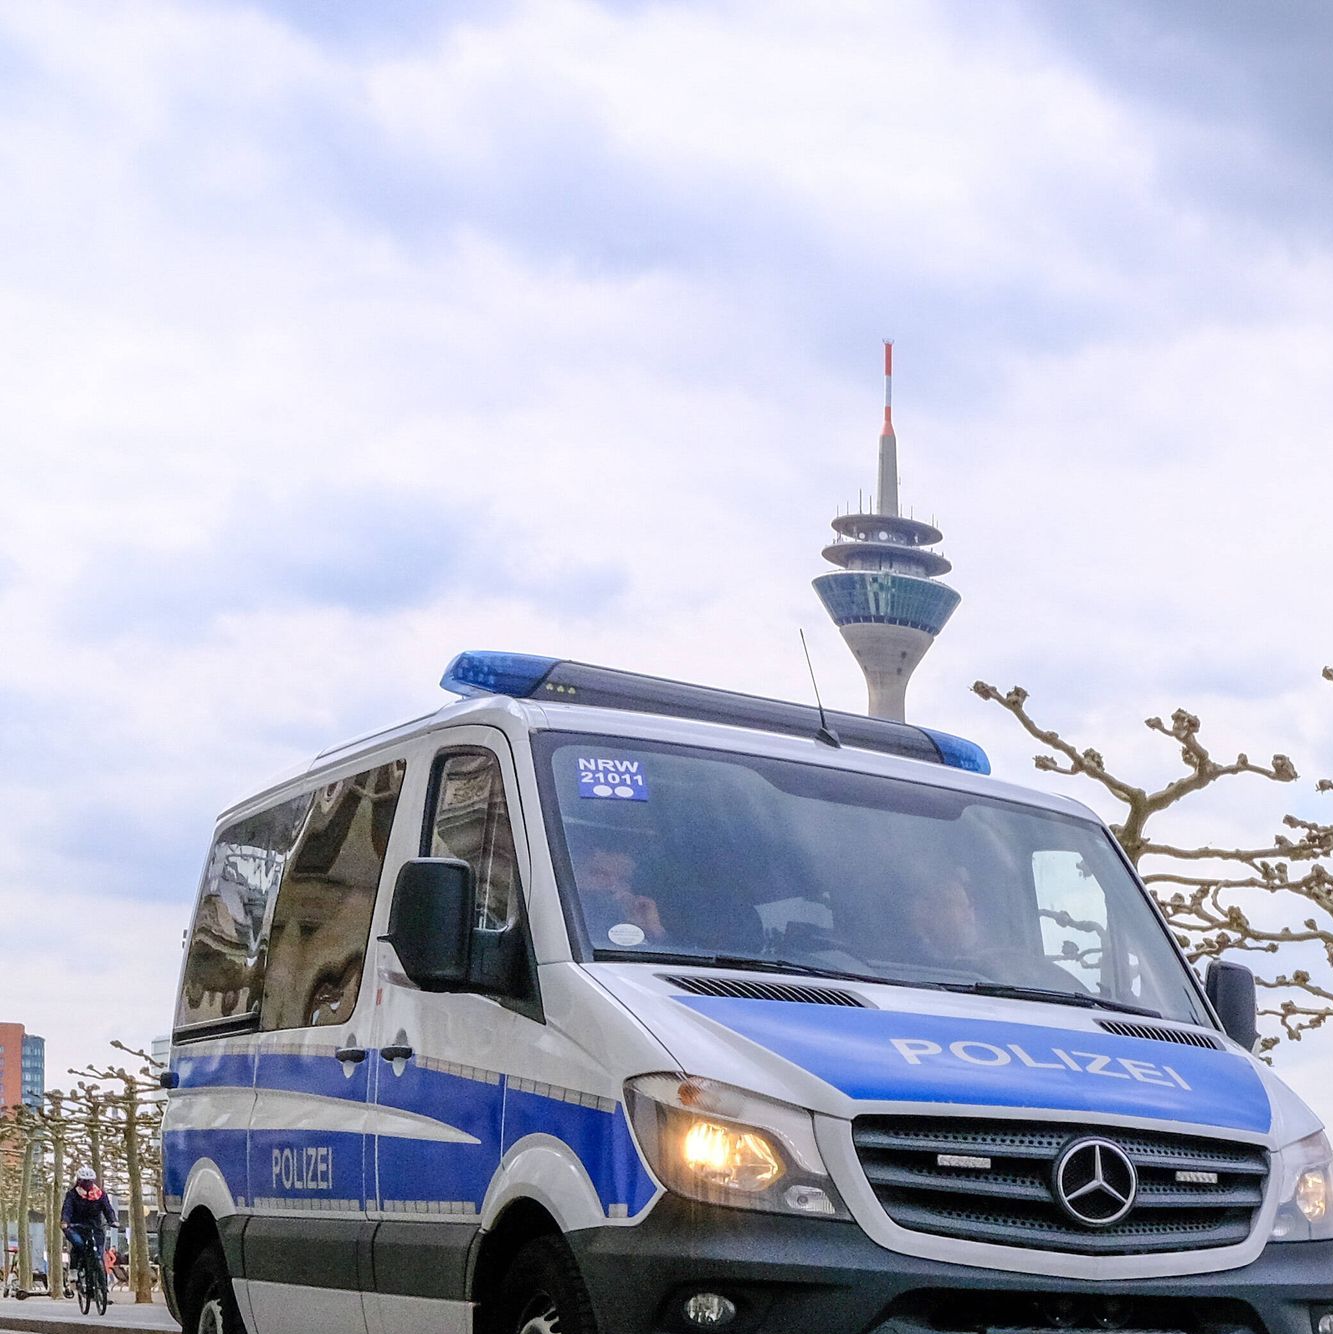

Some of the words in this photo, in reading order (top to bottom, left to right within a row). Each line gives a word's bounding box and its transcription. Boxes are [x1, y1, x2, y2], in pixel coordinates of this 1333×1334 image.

[578, 758, 639, 773] NRW
[580, 771, 643, 786] 21011
[889, 1038, 1193, 1091] POLIZEI
[272, 1147, 333, 1190] POLIZEI
